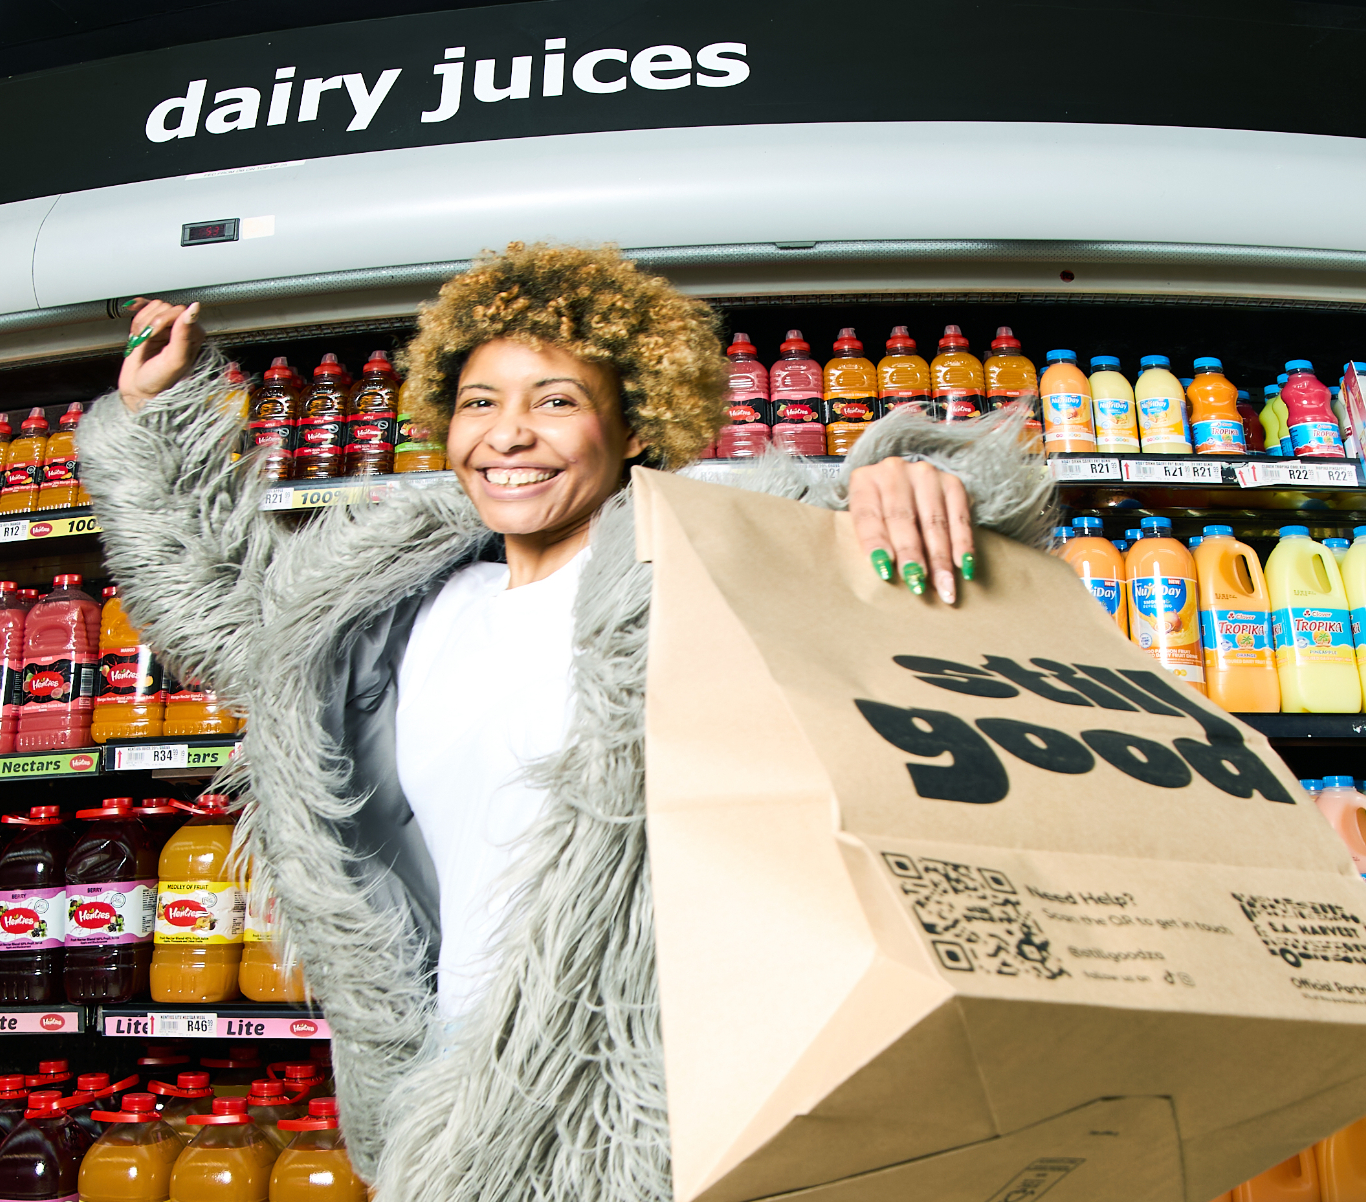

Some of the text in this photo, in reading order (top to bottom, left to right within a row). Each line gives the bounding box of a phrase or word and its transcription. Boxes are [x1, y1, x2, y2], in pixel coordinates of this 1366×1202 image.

[145, 37, 750, 143] dairy juices
[1219, 622, 1265, 635] TROPIKA
[1295, 618, 1343, 633] TROPIKA
[111, 670, 141, 681] Henties
[32, 677, 59, 690] Henties
[893, 654, 1186, 718] still
[854, 699, 1296, 804] good
[1, 760, 61, 774] Nectars
[1025, 884, 1137, 908] Need Help?
[78, 909, 110, 923] Henties
[168, 907, 201, 919] Henties
[1042, 908, 1080, 923] Scan
[1082, 916, 1106, 926] the
[1109, 915, 1134, 926] QR
[1137, 917, 1153, 926] to
[1156, 918, 1179, 929] get
[1182, 918, 1194, 928] in
[4, 913, 36, 929] Henties
[1269, 922, 1360, 938] S.A. HARVEST
[1291, 977, 1334, 992] Official
[226, 1020, 265, 1036] Lite
